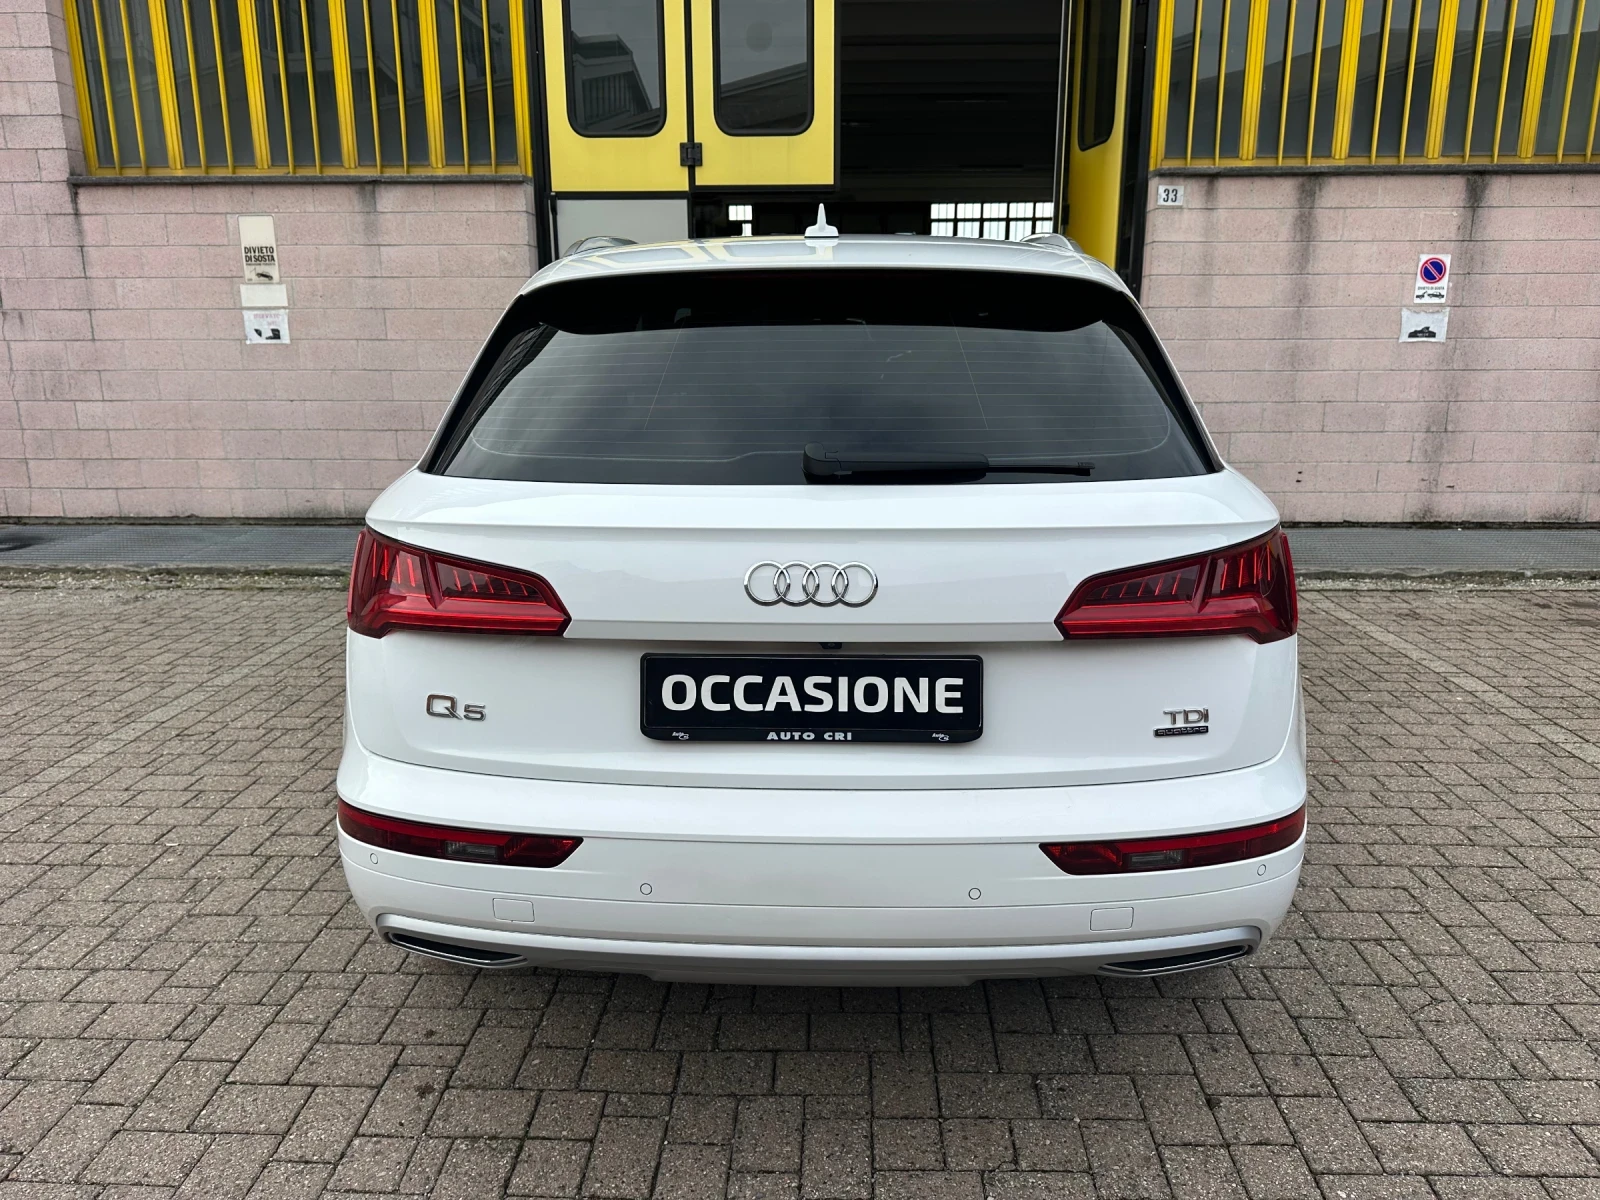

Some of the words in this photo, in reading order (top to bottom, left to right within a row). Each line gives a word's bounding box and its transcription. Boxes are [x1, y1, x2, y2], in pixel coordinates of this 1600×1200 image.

[1163, 188, 1178, 203] 33
[244, 246, 274, 254] DIVIETO
[661, 674, 964, 714] OCCASIONE
[426, 694, 486, 721] Q5
[1163, 708, 1209, 725] TDI
[766, 731, 815, 741] AUTO
[823, 732, 852, 741] CRI
[1156, 726, 1208, 736] quattro
